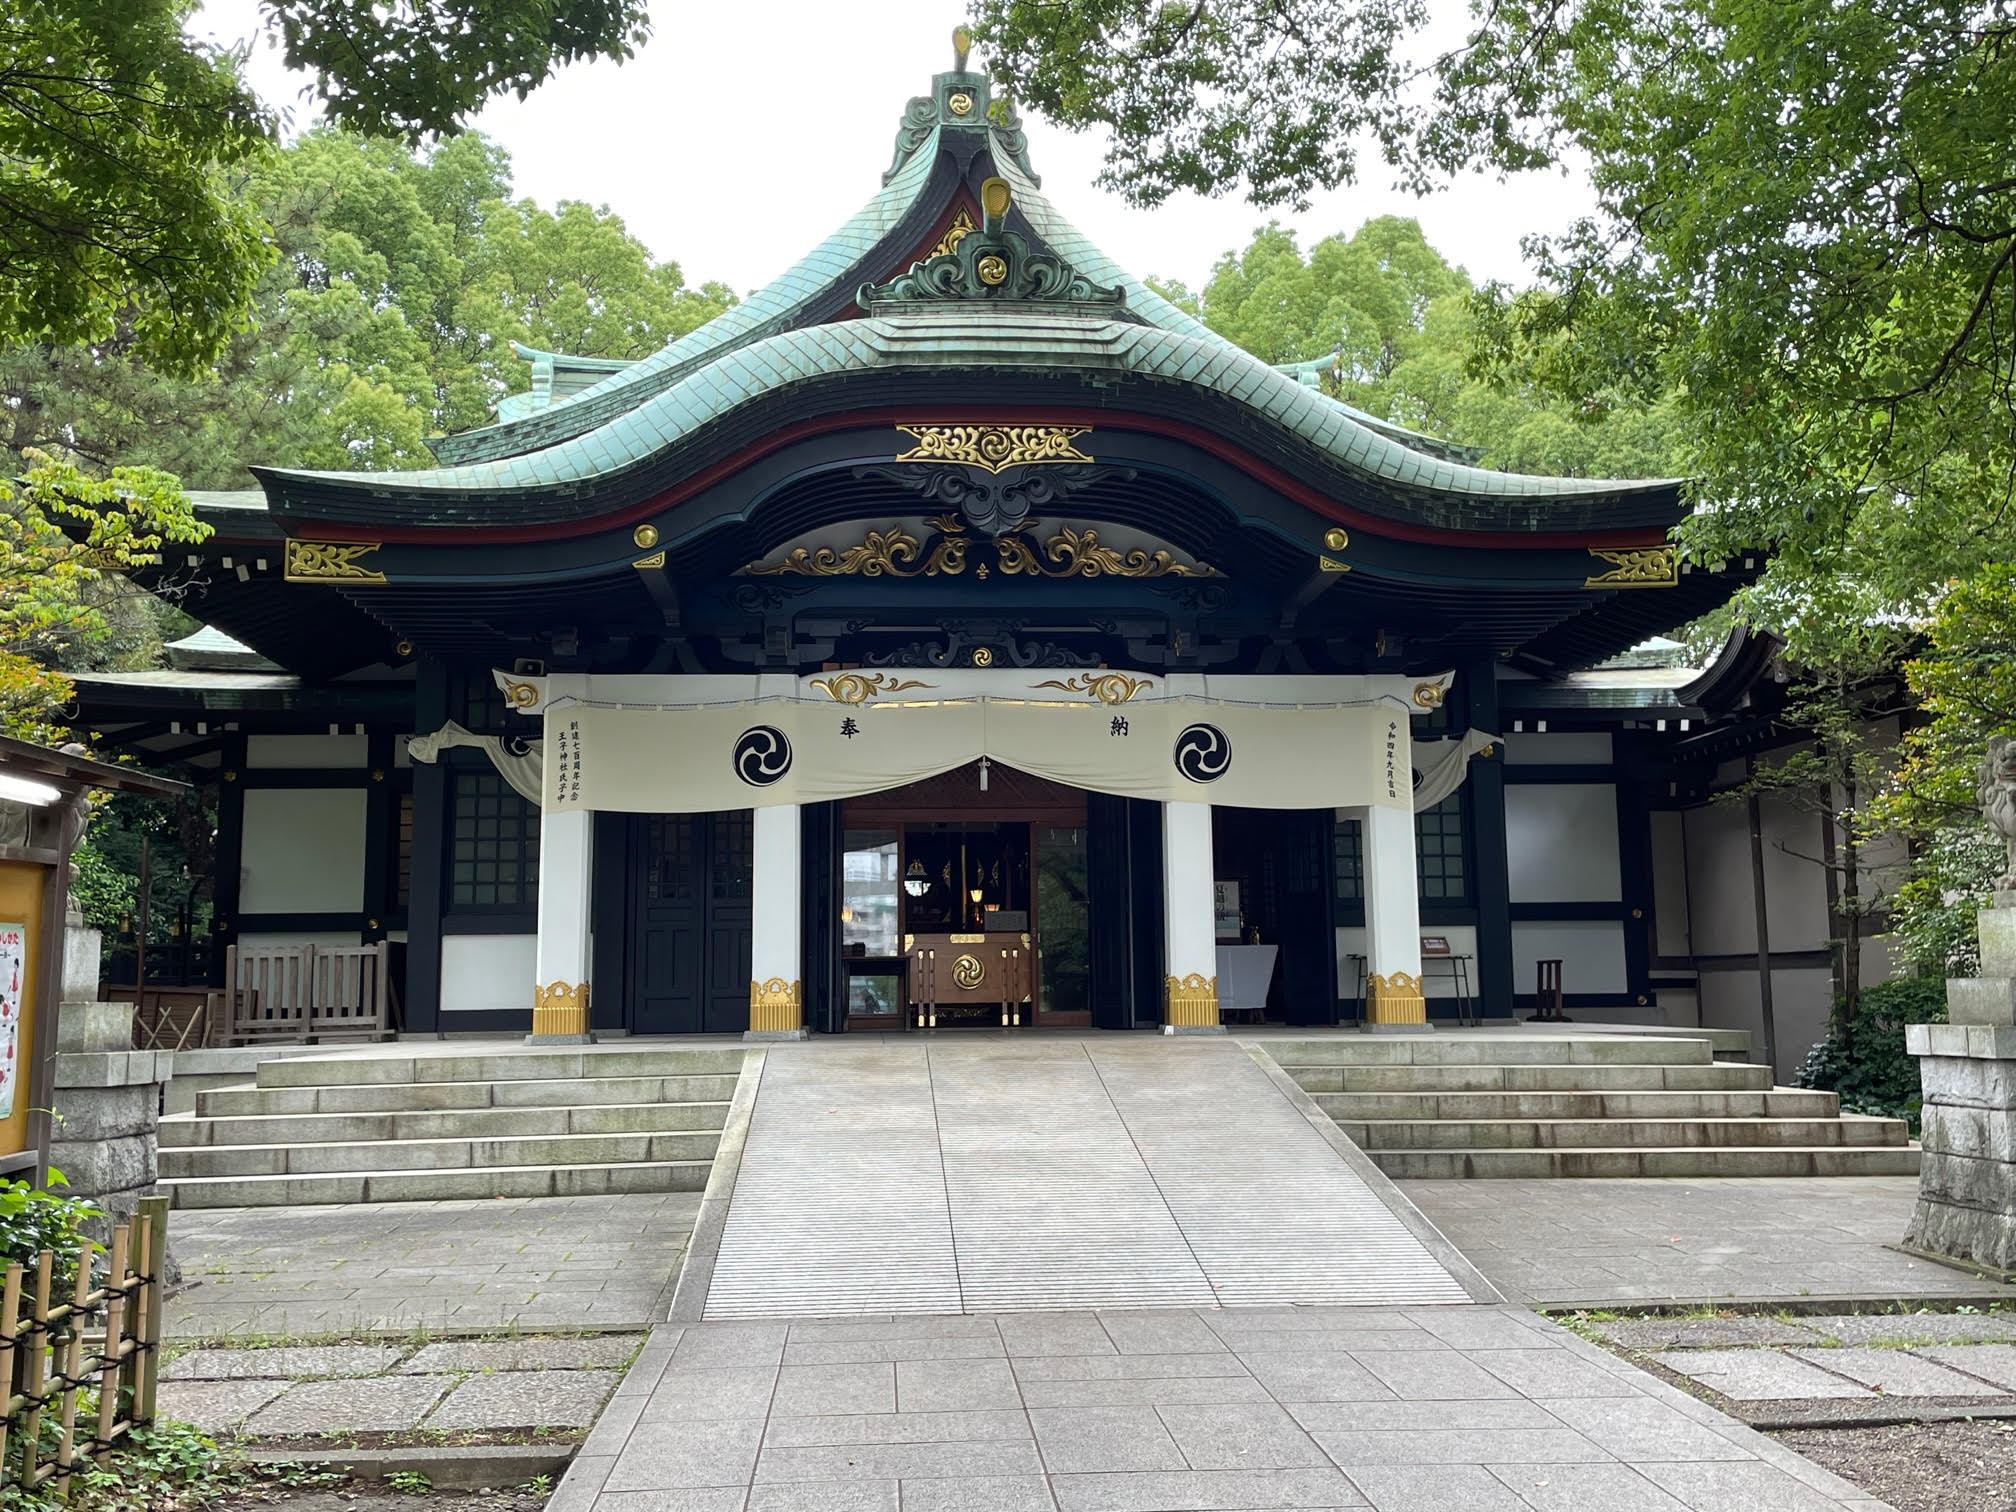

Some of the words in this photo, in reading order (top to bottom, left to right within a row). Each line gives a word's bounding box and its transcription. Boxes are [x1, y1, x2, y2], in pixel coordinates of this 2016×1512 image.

[840, 717, 860, 739] 奉
[1110, 716, 1129, 737] 納
[557, 732, 568, 803] 王子神社氏子中
[1386, 721, 1397, 798] 令和四年九月吉日
[0, 932, 19, 945] しかた
